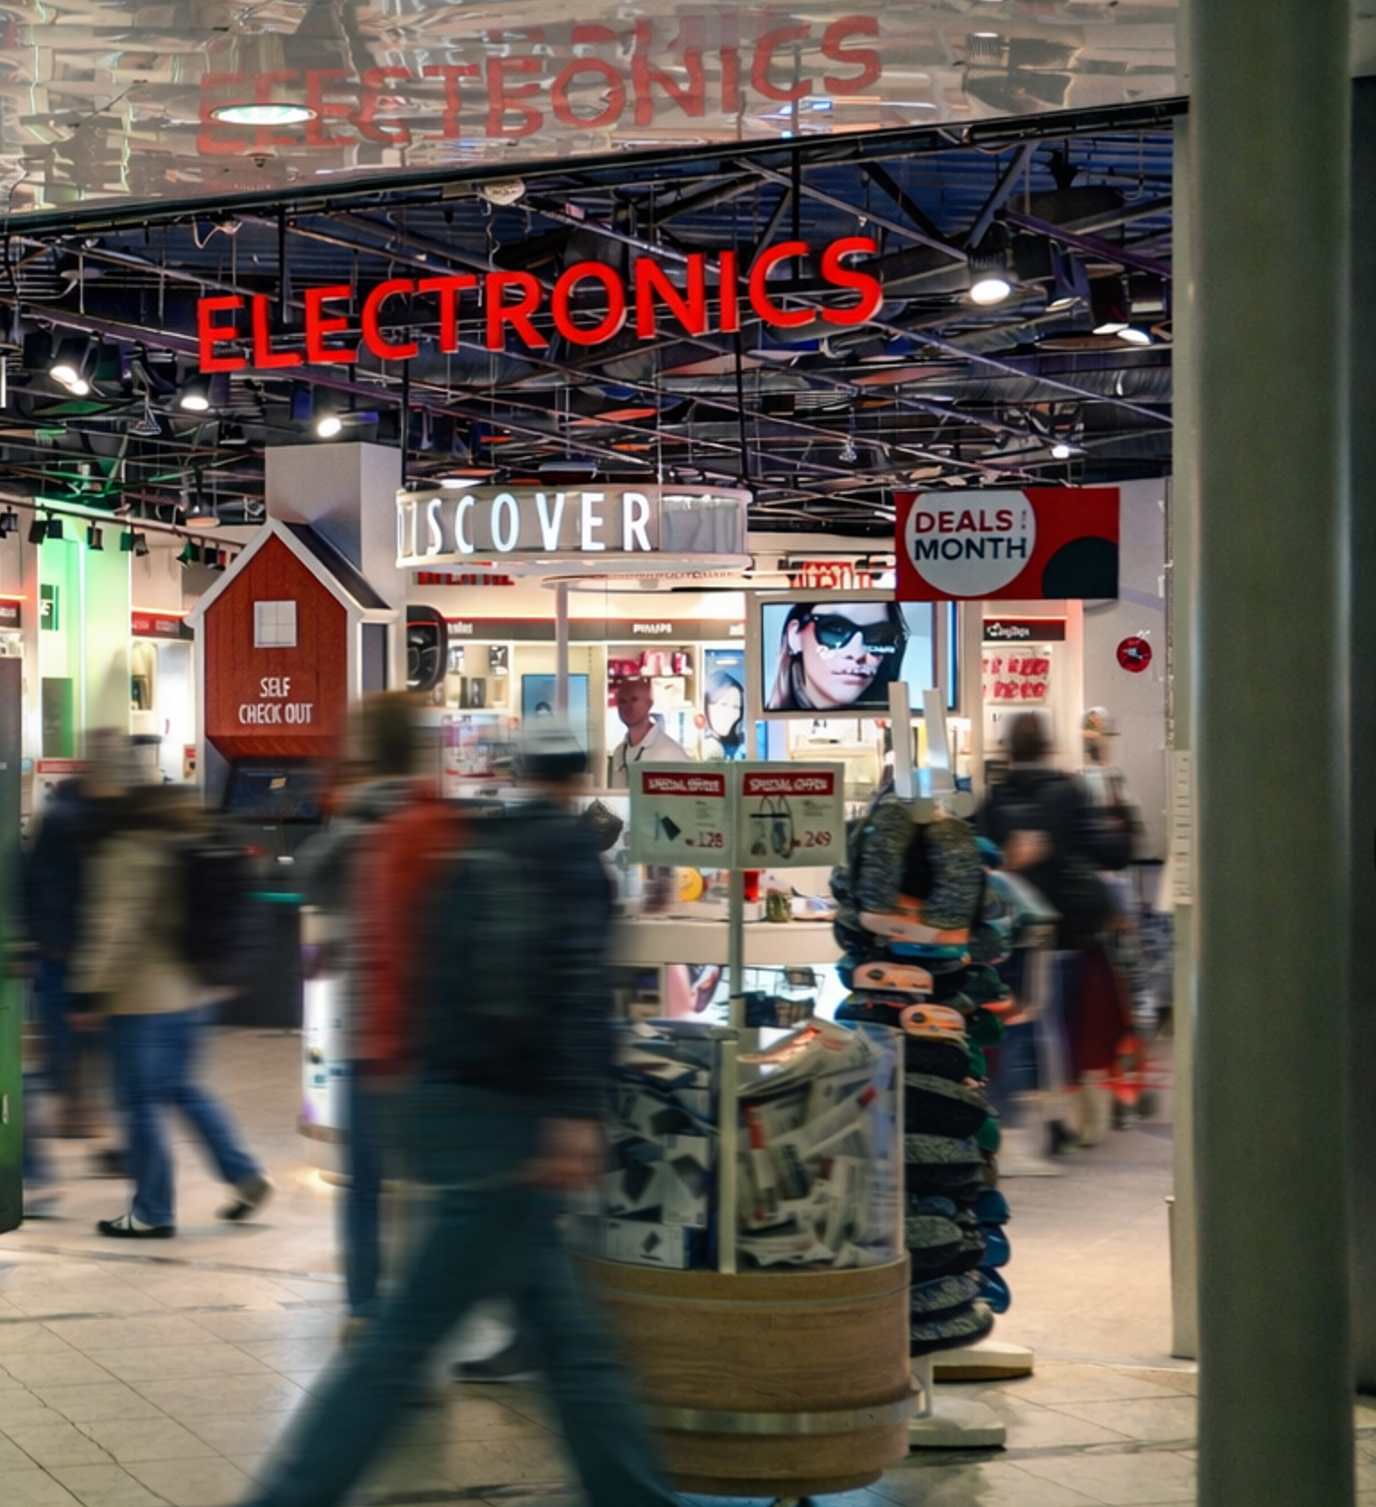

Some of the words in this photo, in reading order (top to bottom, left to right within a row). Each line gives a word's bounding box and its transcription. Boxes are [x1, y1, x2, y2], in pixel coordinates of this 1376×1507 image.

[197, 237, 885, 373] ELECTRONICS
[914, 509, 1013, 534] DEALS
[914, 537, 1027, 560] MONTH
[259, 677, 291, 698] SELF
[238, 703, 281, 724] CHECK
[284, 703, 313, 723] OUT
